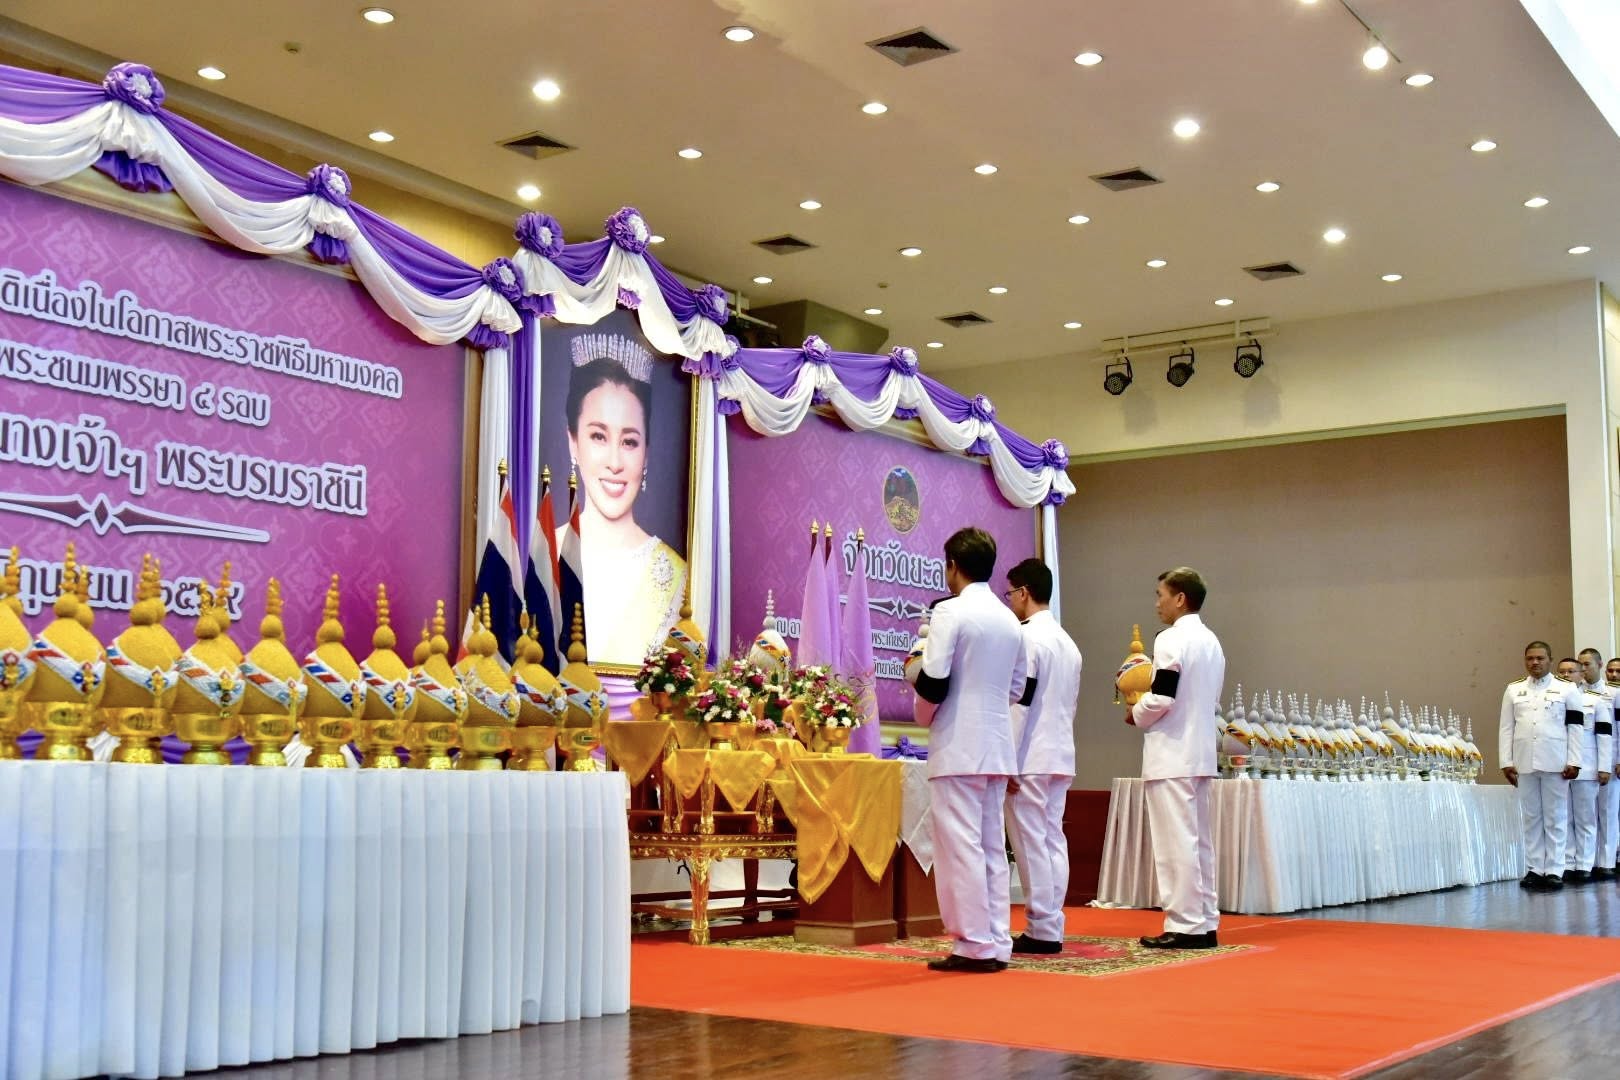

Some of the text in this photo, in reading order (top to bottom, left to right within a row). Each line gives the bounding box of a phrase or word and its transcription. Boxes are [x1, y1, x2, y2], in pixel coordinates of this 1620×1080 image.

[194, 387, 211, 410] ๔
[221, 391, 267, 421] รอบ
[160, 446, 363, 511] พระบรมราชินี
[843, 534, 946, 590] จังหวัดยะล
